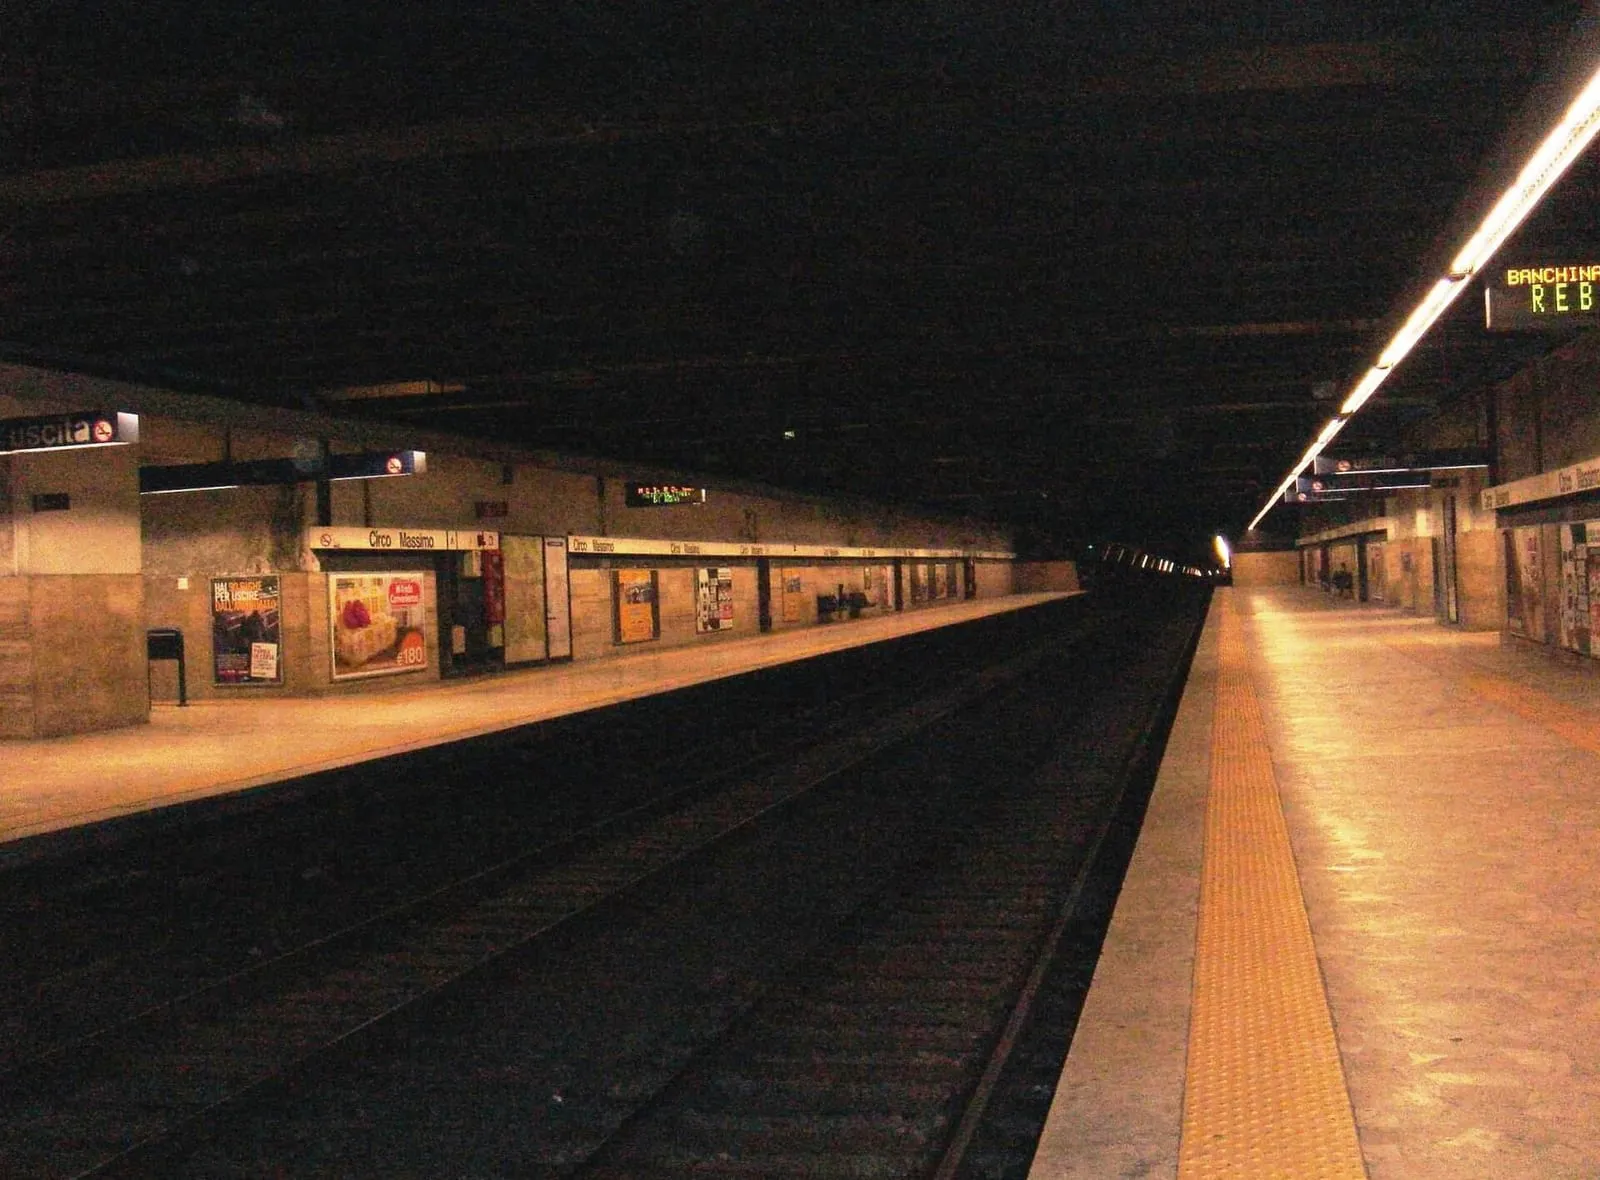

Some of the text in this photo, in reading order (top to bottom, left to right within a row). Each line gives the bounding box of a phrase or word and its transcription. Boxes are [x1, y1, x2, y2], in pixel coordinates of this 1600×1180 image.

[1507, 265, 1600, 285] BANCHINA
[10, 419, 91, 444] uscita
[369, 530, 434, 549] Circo Massimo
